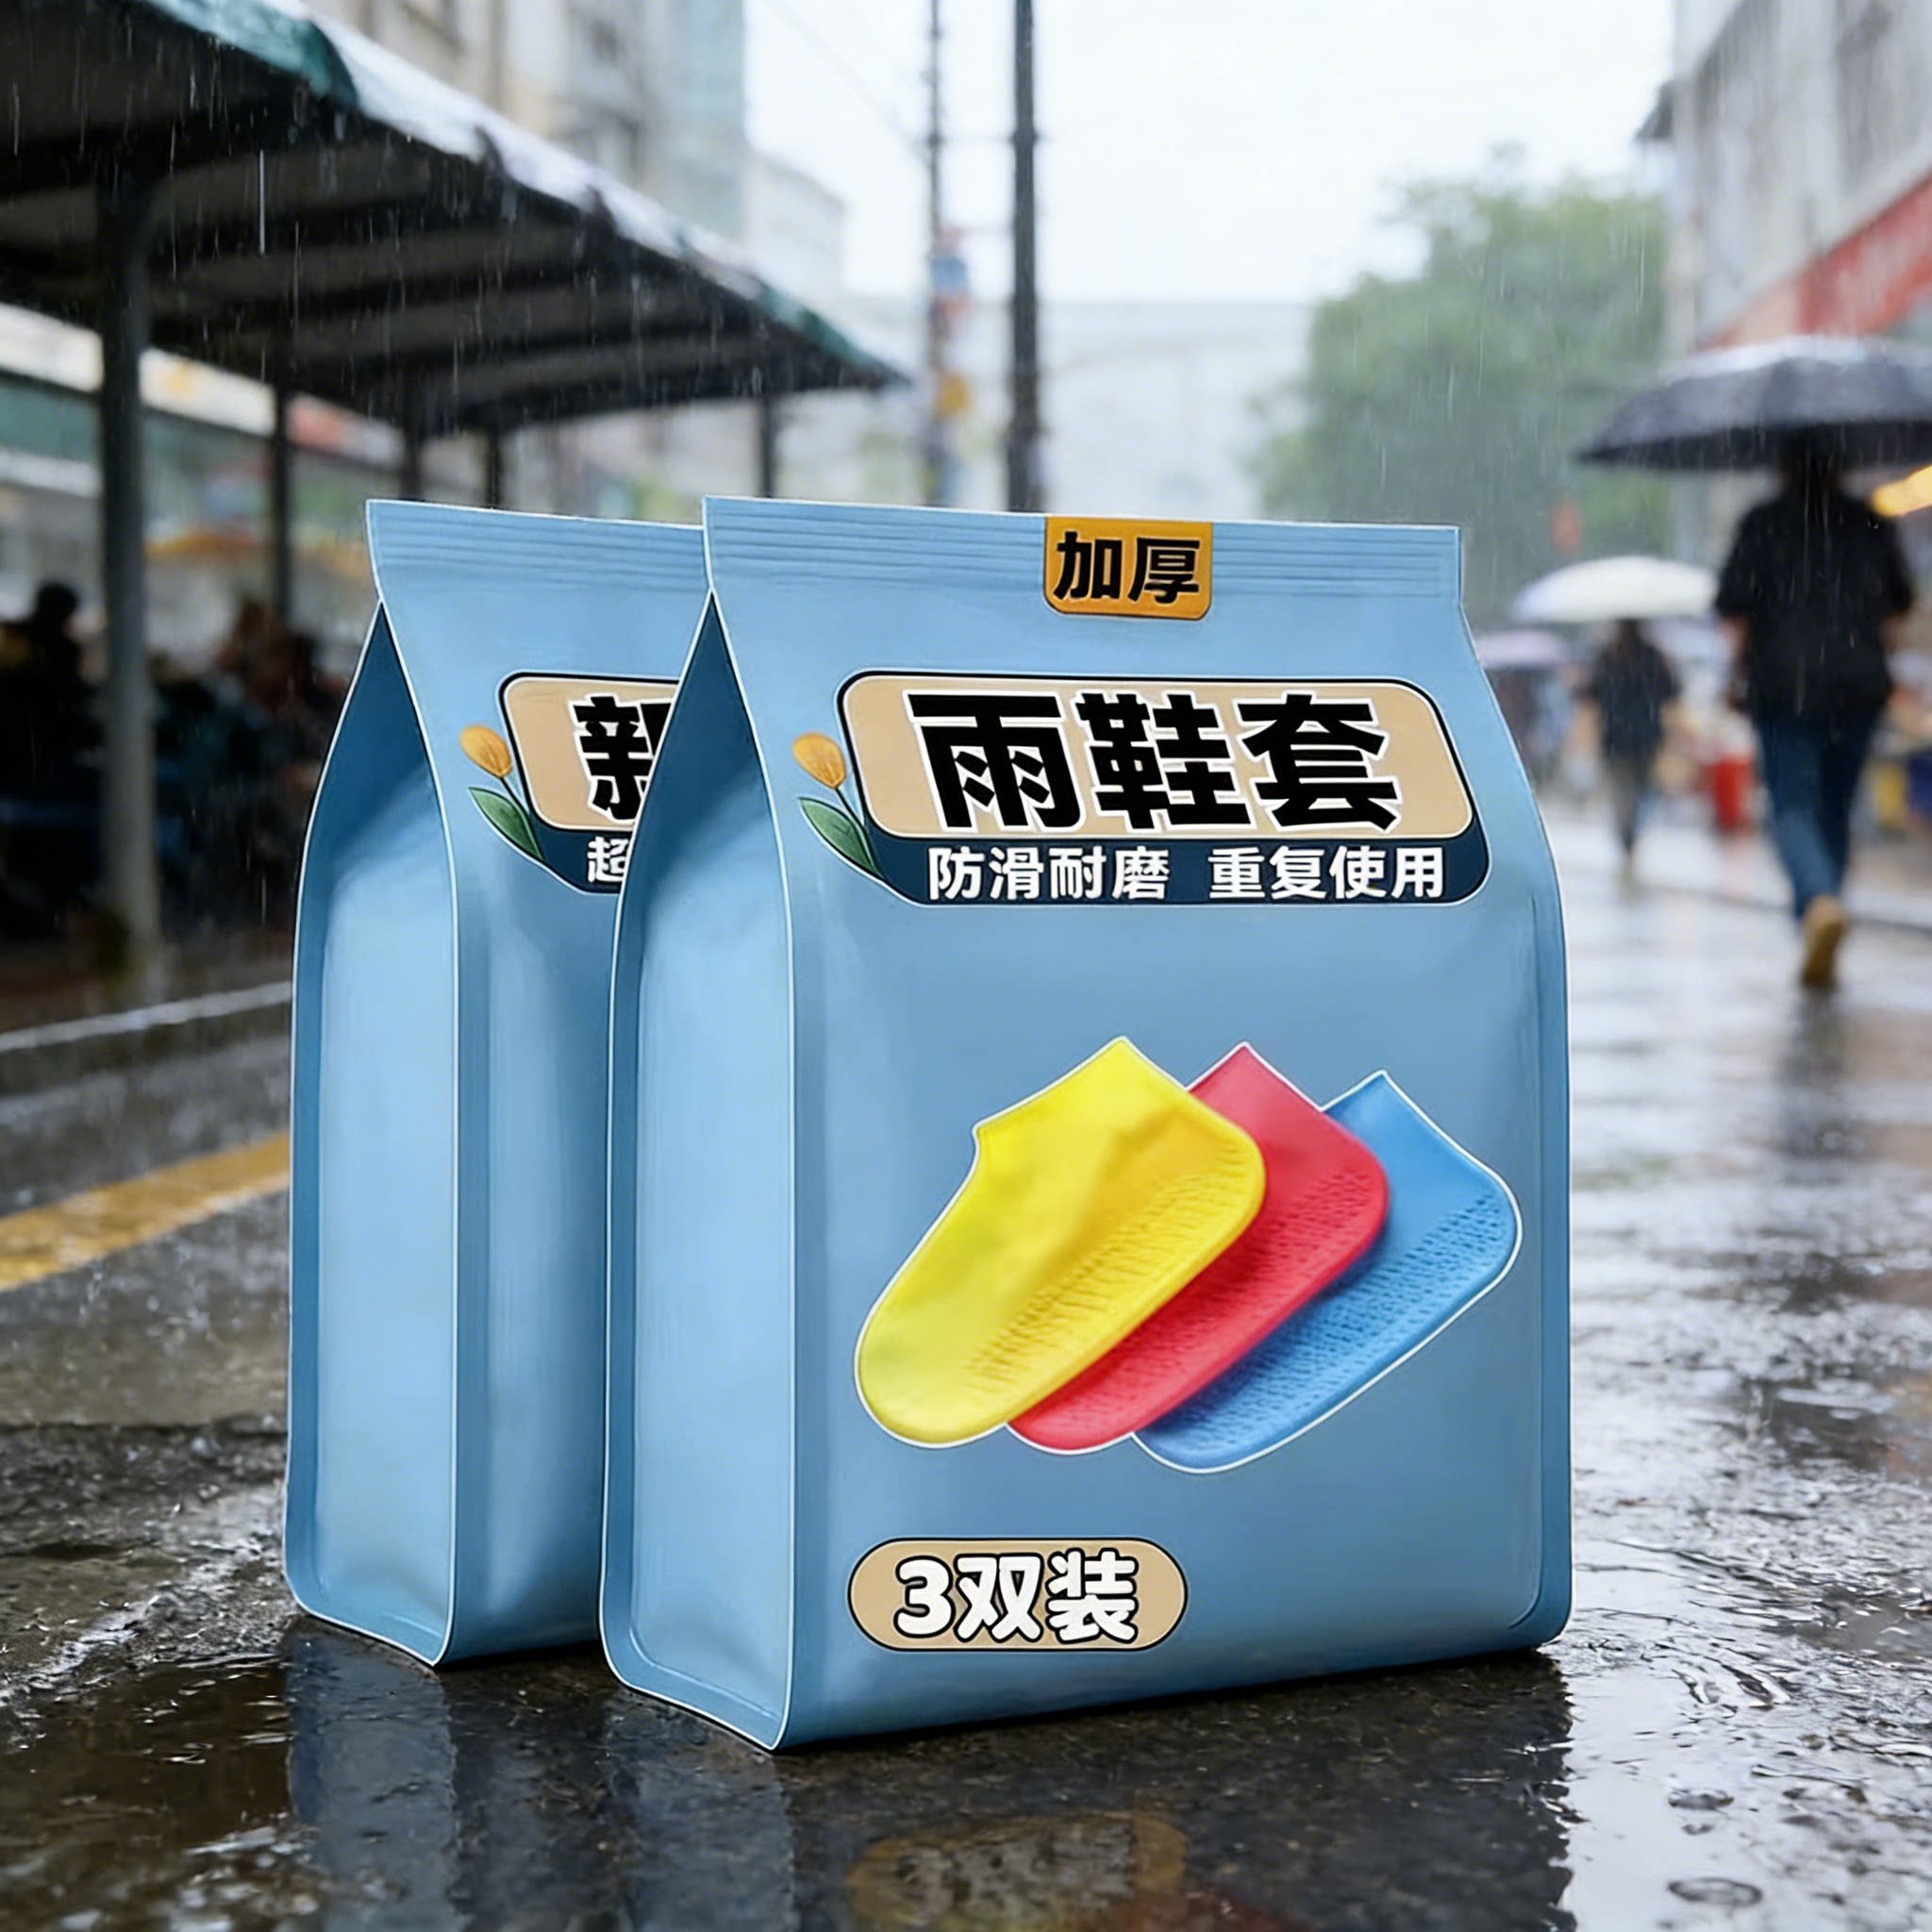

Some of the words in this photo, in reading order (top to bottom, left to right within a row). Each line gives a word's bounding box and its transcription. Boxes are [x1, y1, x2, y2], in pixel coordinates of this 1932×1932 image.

[1053, 529, 1201, 605] 加厚
[904, 691, 1402, 832] 雨鞋套
[928, 845, 1171, 901] 防滑耐磨
[1208, 845, 1444, 902] 重复使用
[893, 1548, 1139, 1644] 3双装
